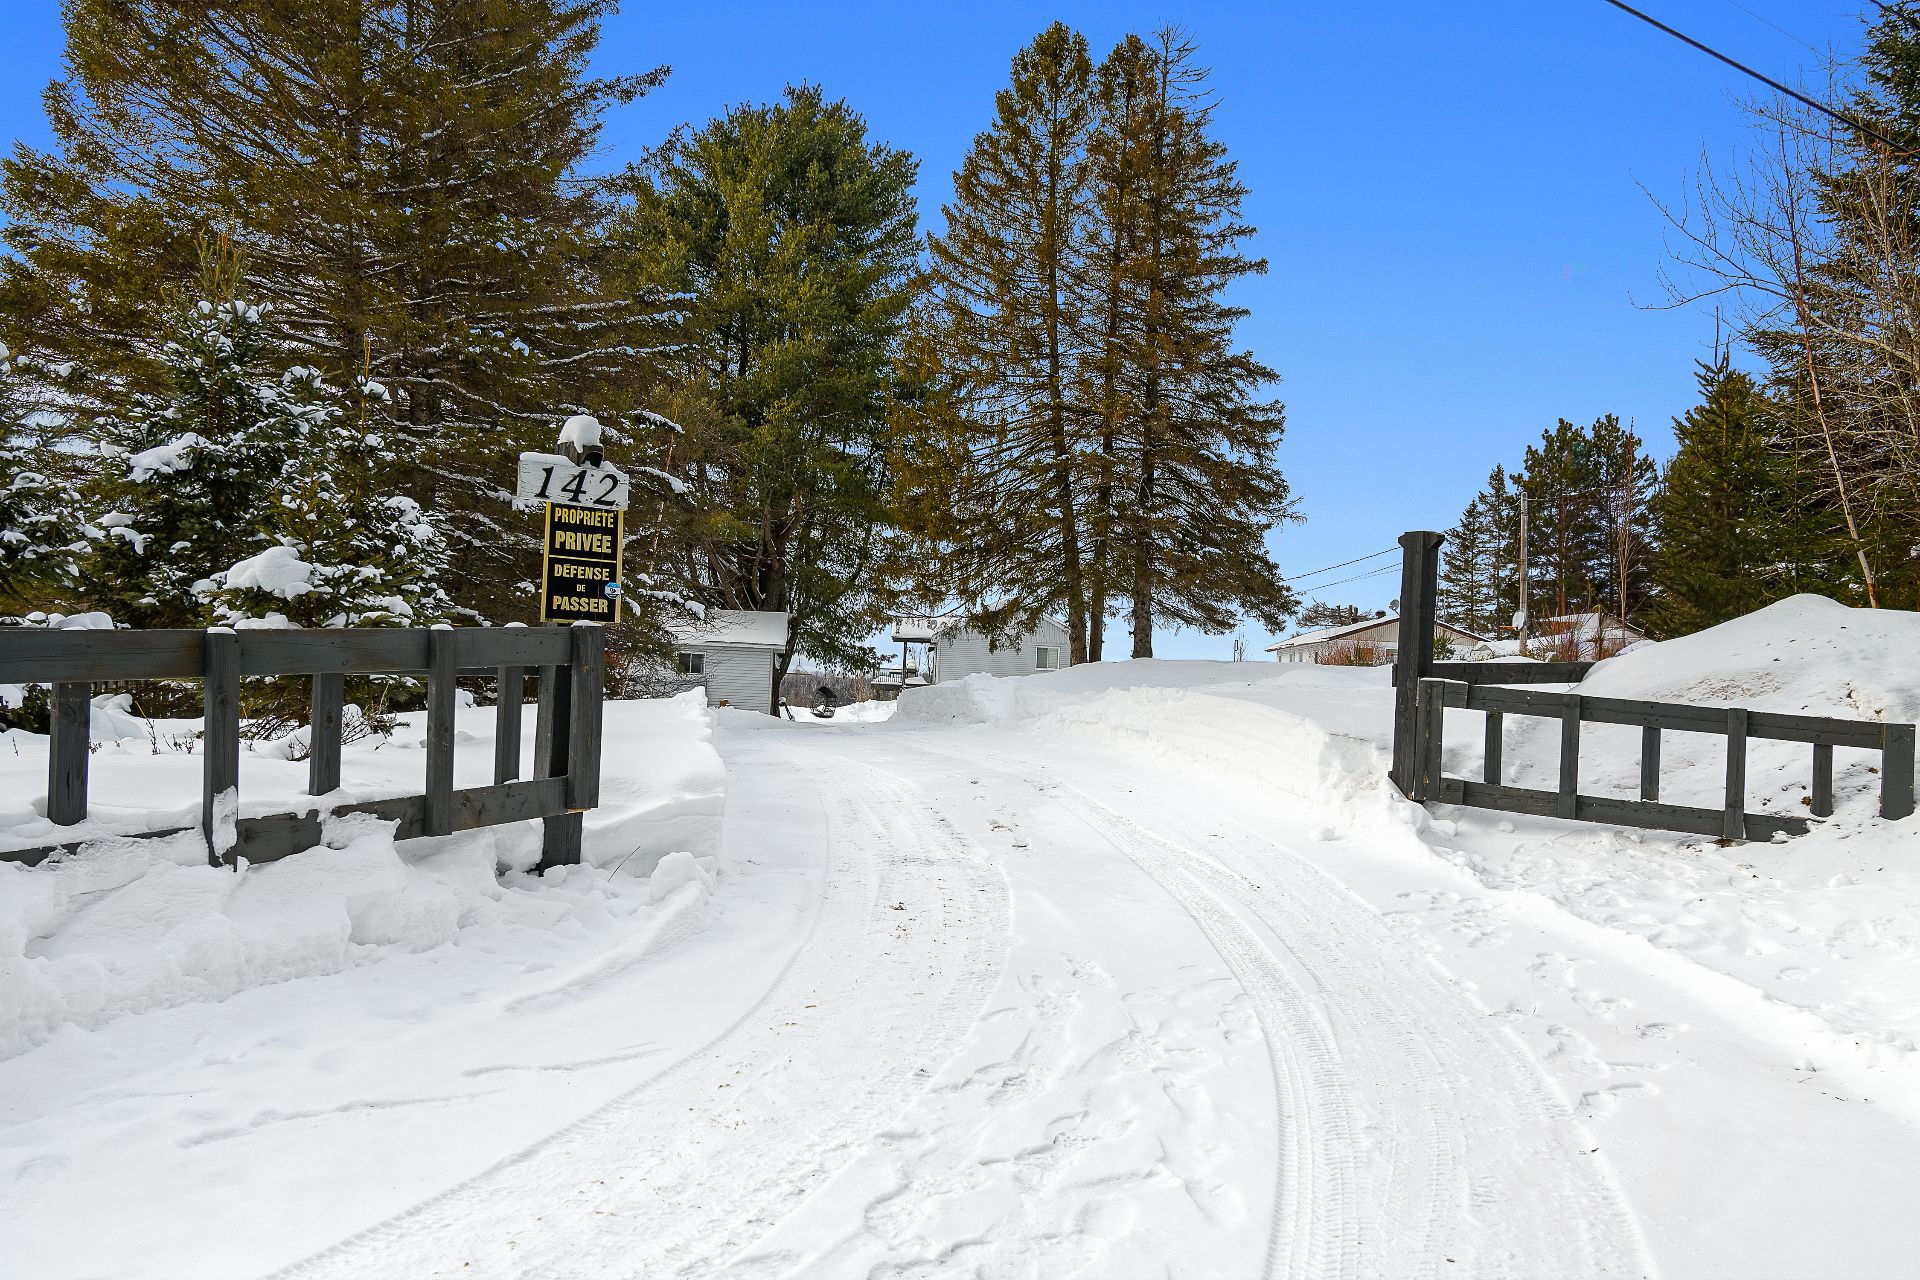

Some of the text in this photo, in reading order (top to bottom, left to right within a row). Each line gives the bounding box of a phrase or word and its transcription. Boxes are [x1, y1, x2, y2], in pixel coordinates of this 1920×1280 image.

[534, 466, 619, 506] 142
[576, 584, 586, 593] DE
[552, 595, 608, 613] PASSER
